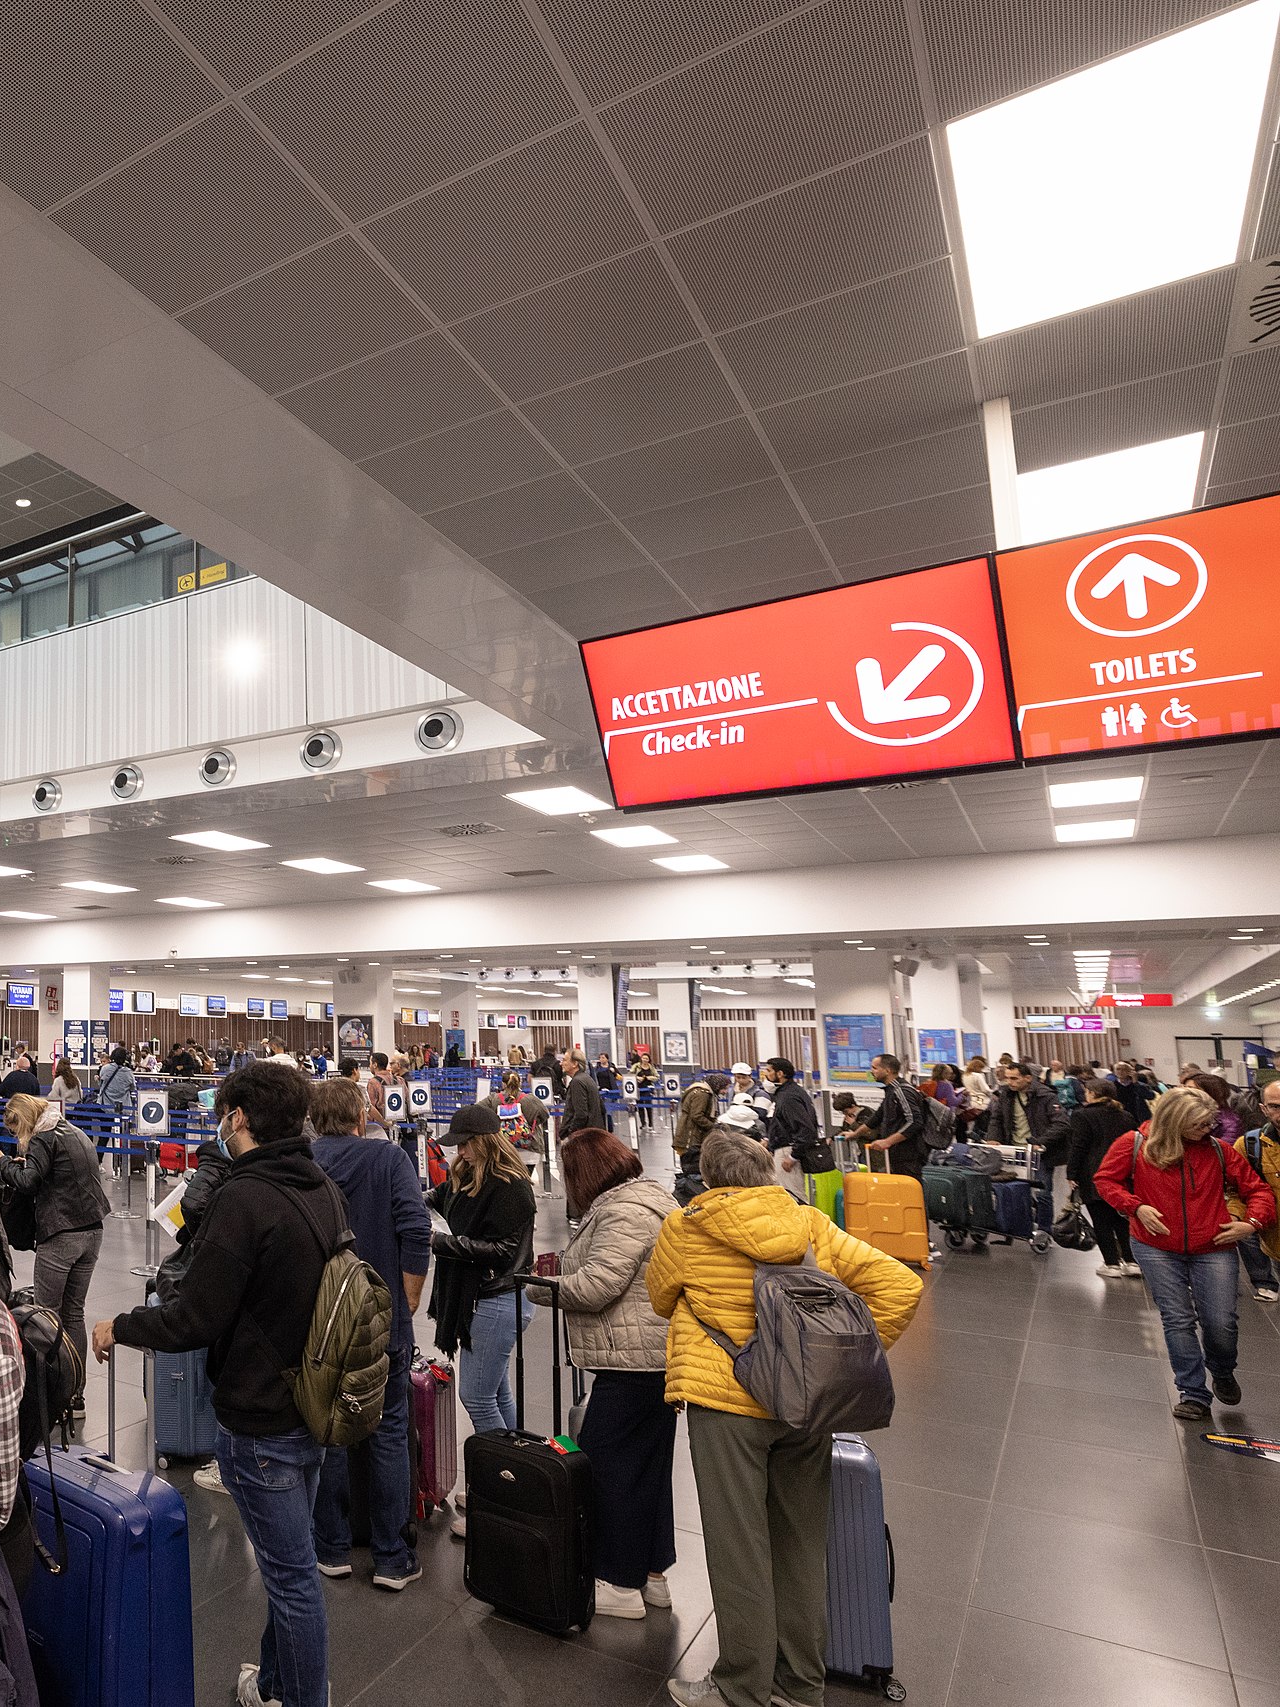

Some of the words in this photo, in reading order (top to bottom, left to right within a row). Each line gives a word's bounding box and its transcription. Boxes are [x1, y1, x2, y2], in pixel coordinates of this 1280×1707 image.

[1090, 648, 1197, 687] TOILETS
[611, 671, 764, 722] ACCETTAZIONE
[641, 721, 746, 757] Check-in
[414, 1092, 426, 1102] 10
[538, 1087, 547, 1097] 11
[391, 1098, 399, 1107] 9
[149, 1107, 157, 1118] 7
